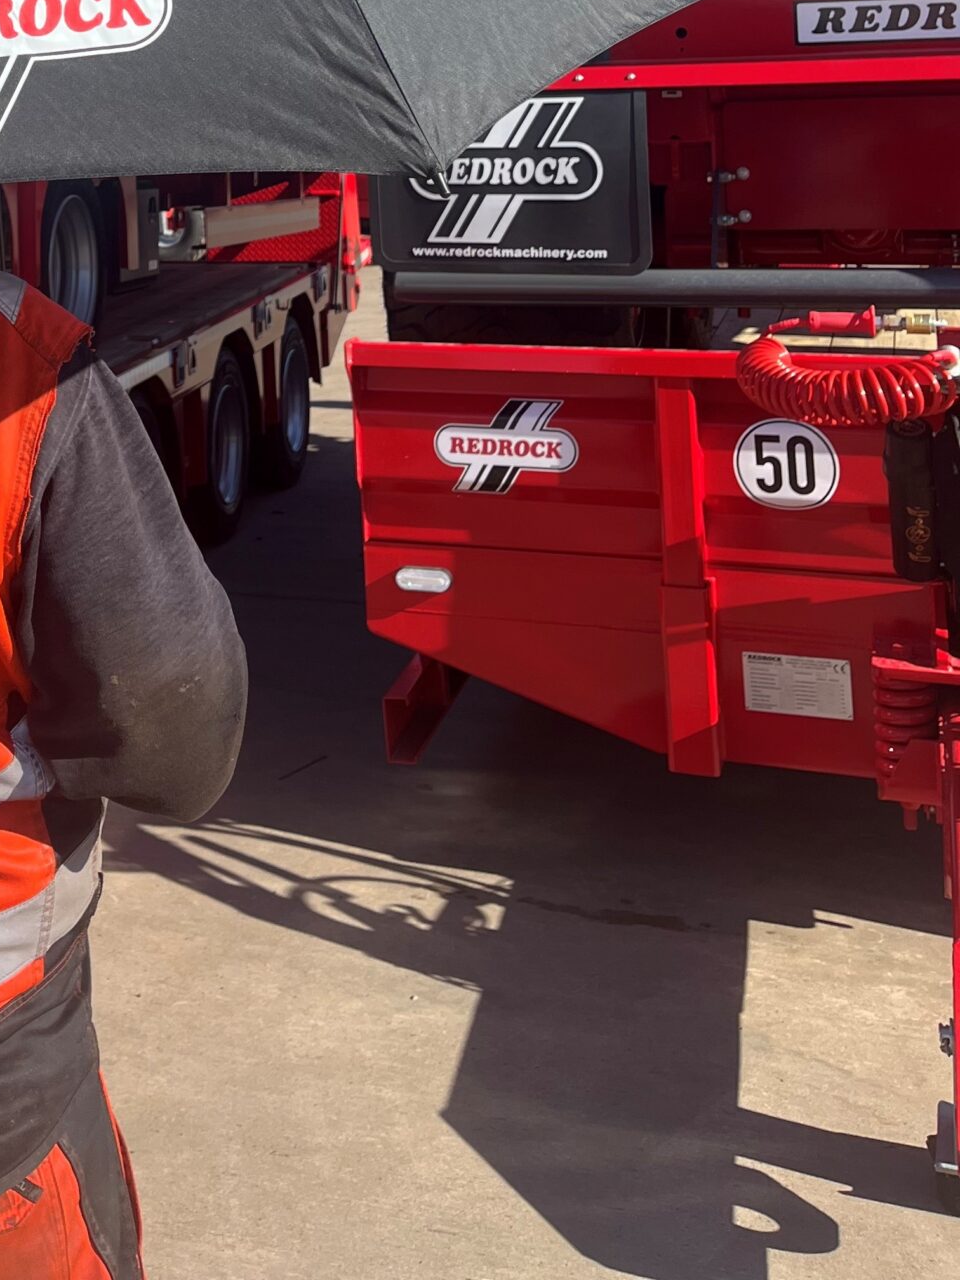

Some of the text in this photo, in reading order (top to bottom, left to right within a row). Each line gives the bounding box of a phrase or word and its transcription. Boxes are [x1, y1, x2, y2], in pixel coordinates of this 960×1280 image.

[811, 2, 957, 34] REDR
[427, 156, 580, 185] EDROCK
[412, 246, 608, 261] www.redrockmachinery.com
[449, 436, 563, 460] REDROCK
[754, 433, 816, 495] 50
